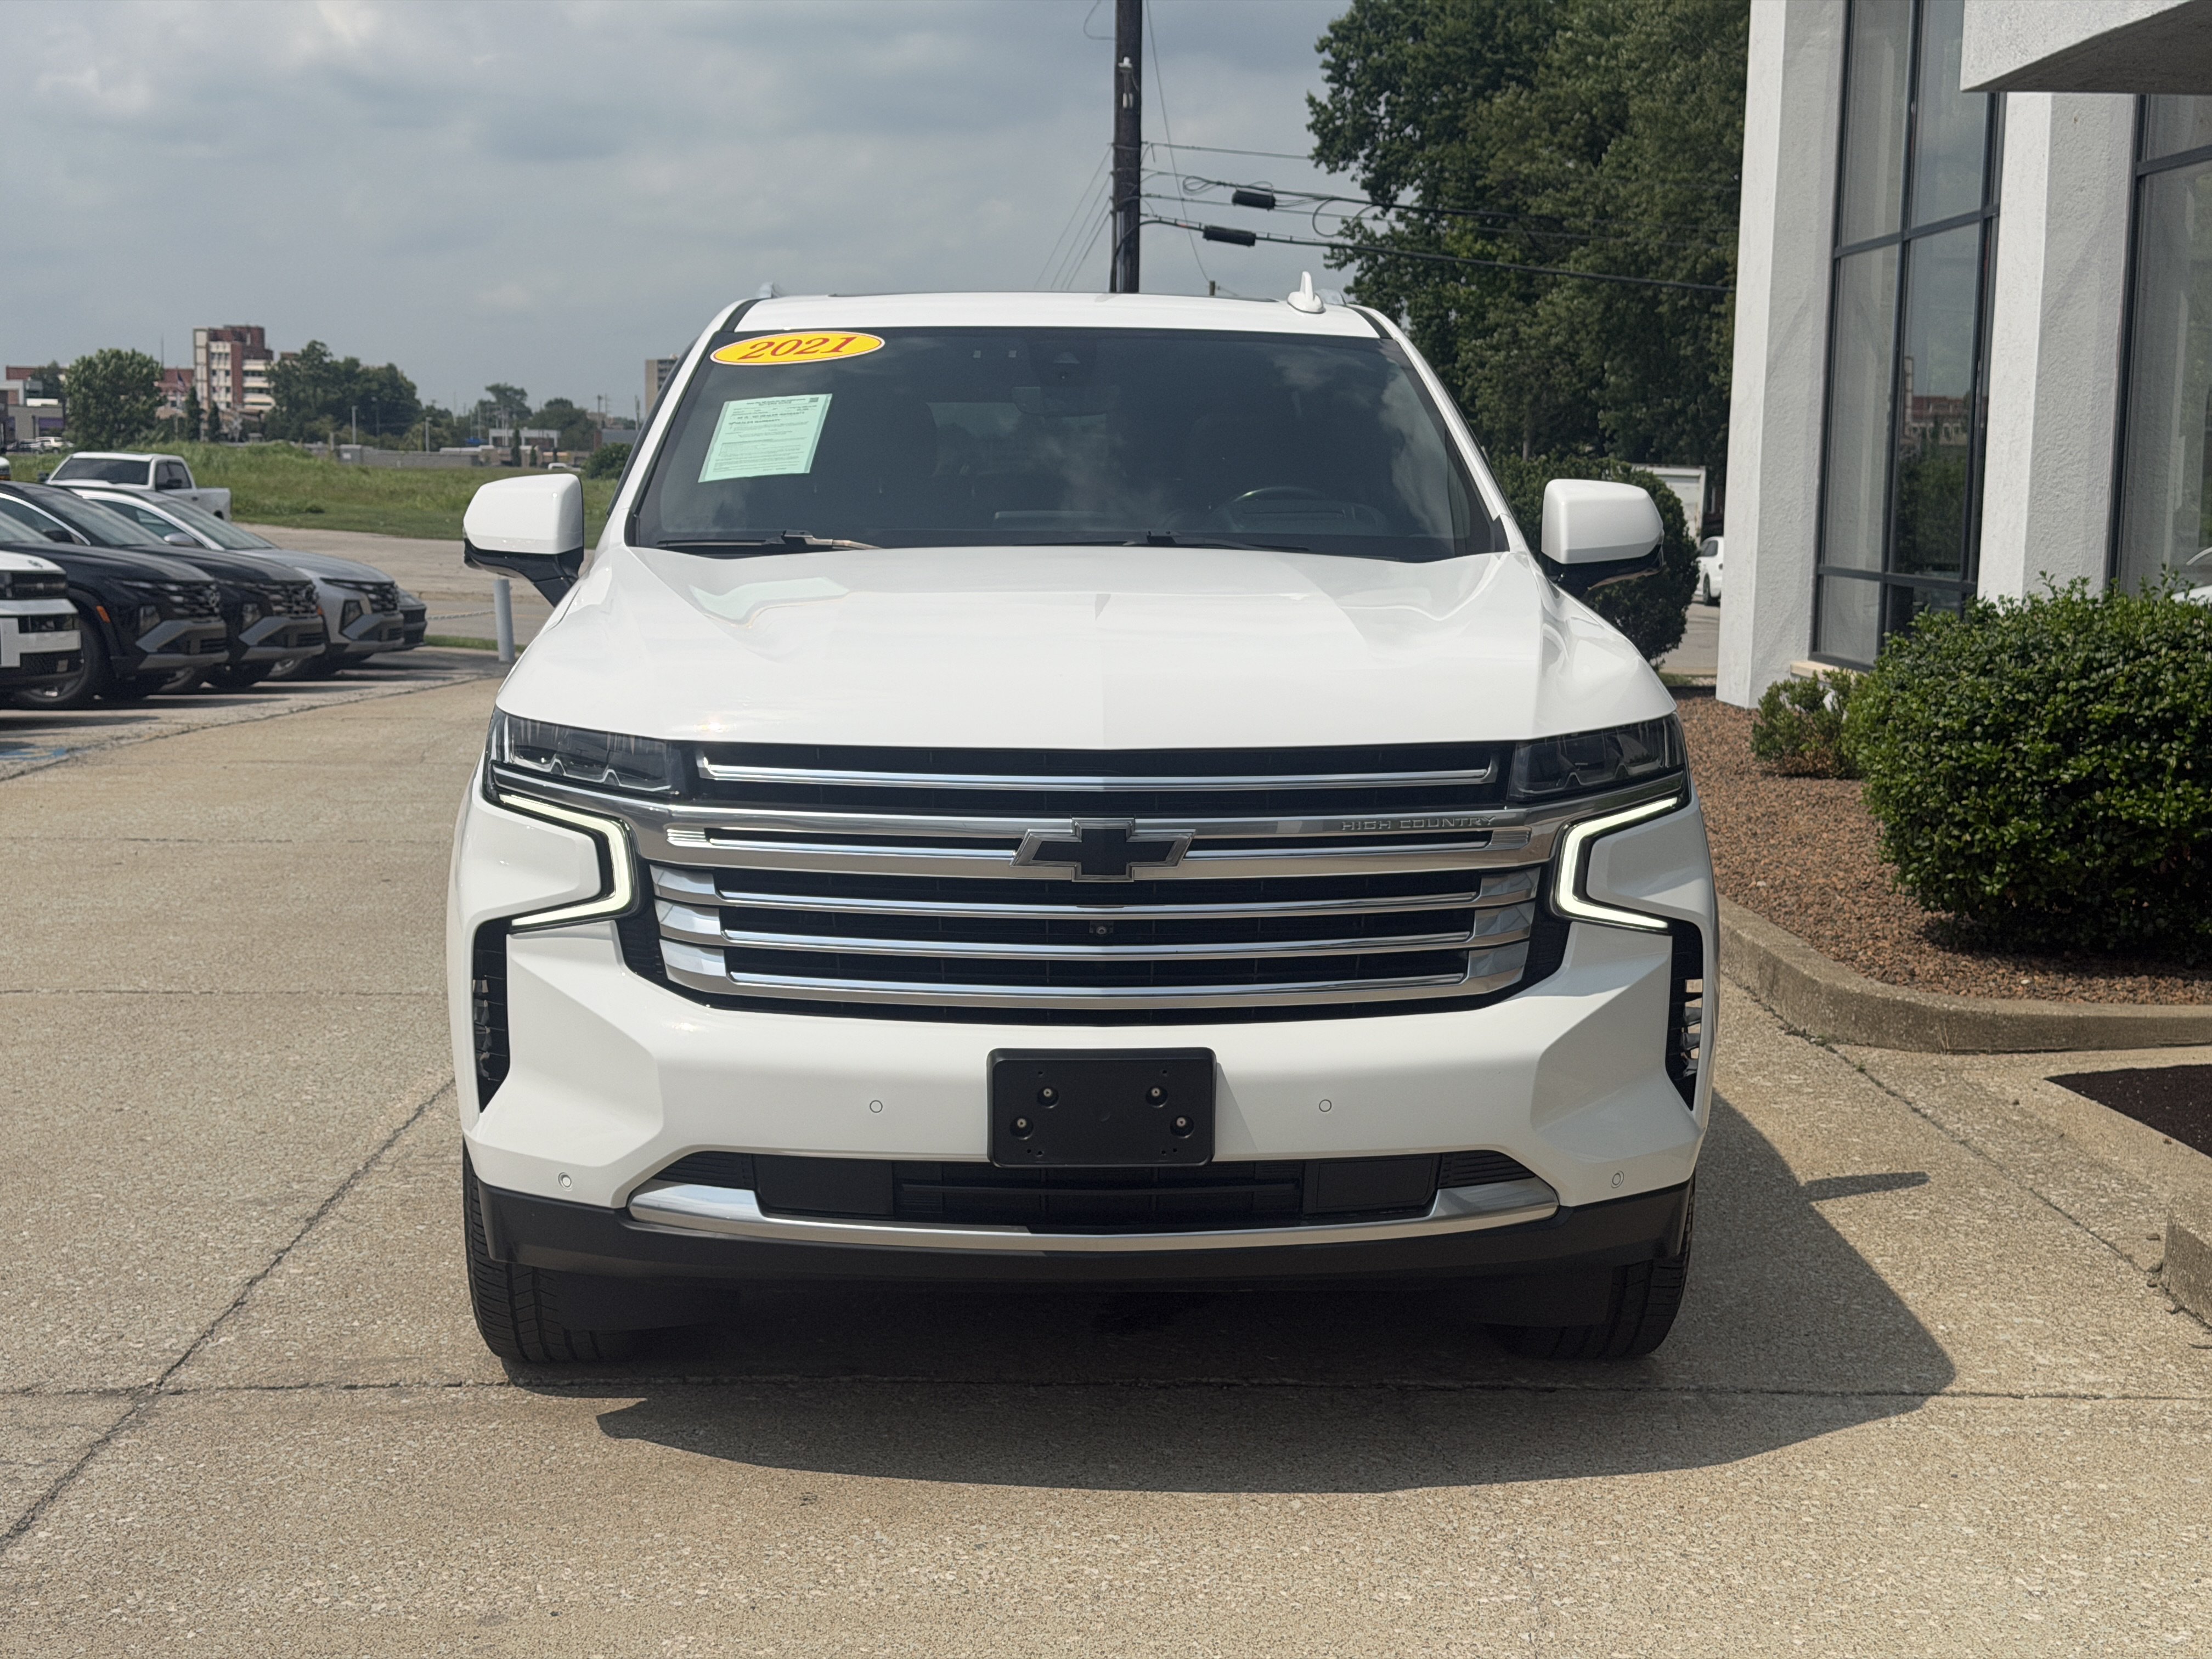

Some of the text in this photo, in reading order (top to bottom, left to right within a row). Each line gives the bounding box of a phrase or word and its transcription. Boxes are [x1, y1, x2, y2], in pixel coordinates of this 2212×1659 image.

[737, 336, 857, 360] 2021
[1342, 816, 1496, 831] HIGH COUNTRY
